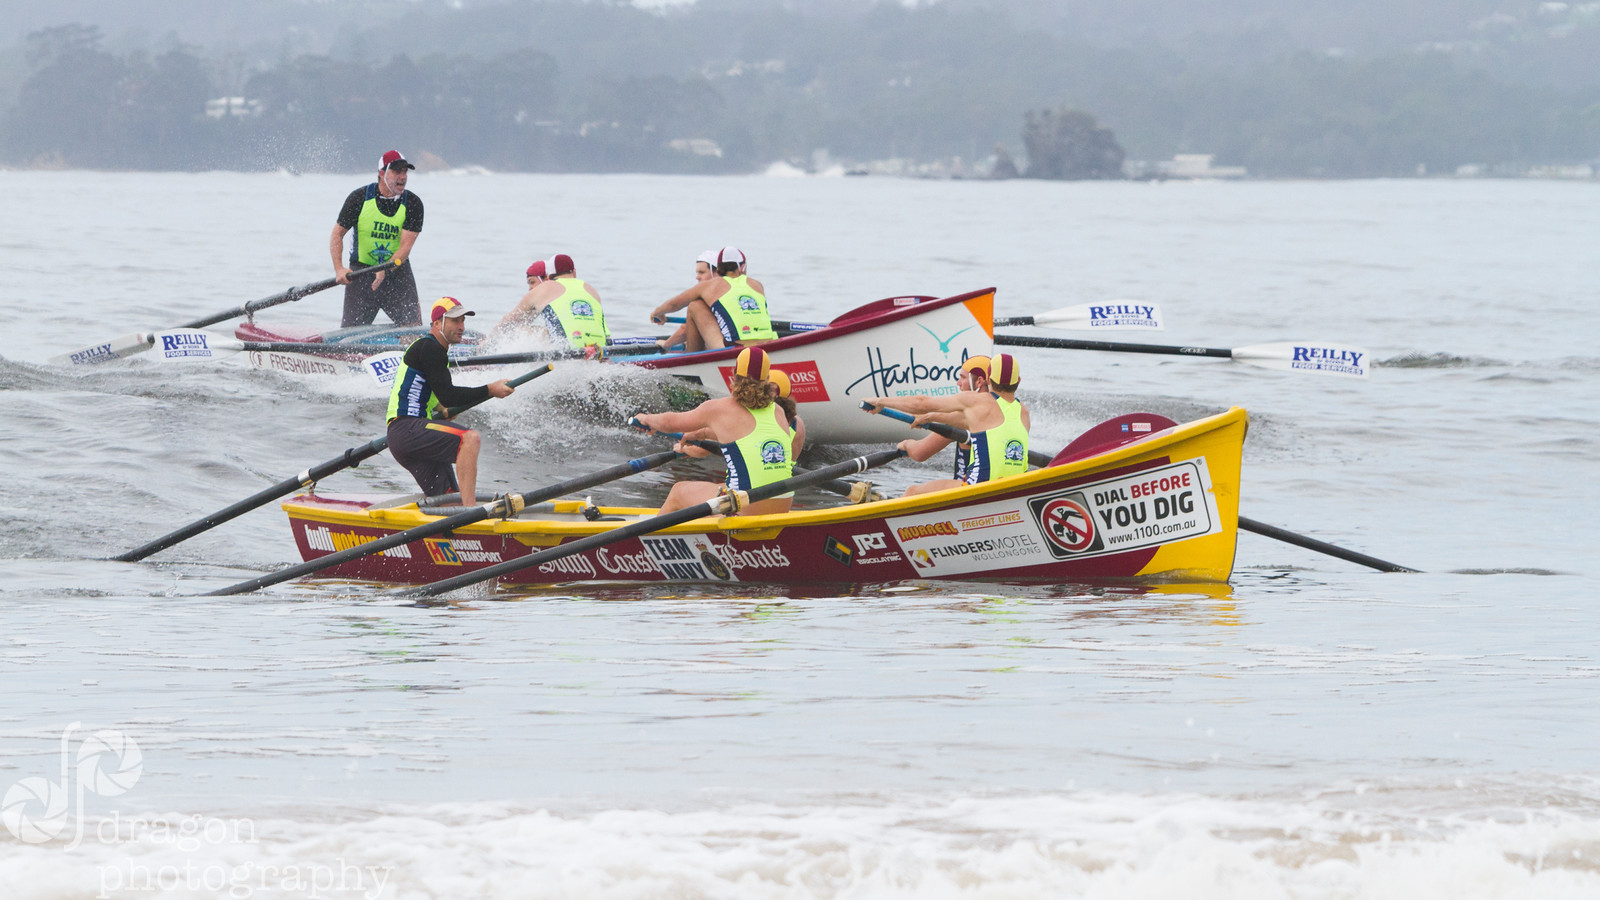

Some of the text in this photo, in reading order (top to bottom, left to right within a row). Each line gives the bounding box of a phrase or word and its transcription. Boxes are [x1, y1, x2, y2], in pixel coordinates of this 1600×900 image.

[371, 231, 398, 241] NAVY
[373, 221, 400, 234] TEAM
[1088, 305, 1154, 320] REILLY
[161, 333, 208, 351] REILLY
[70, 343, 112, 365] REILLY
[1292, 346, 1364, 367] REILLY
[269, 353, 338, 375] FRESHWATER
[790, 371, 816, 383] ORS
[896, 388, 928, 397] BEACH
[1094, 472, 1191, 507] DIAL BEFORE
[1098, 490, 1194, 530] YOU DIG
[897, 512, 1022, 543] MURRELL FREIGHT LINES
[1108, 519, 1196, 544] www.1100.com.au
[426, 541, 459, 563] HTS
[450, 539, 484, 551] HORNBY
[642, 538, 696, 560] TEAM
[852, 532, 888, 557] JRT
[971, 546, 1042, 562] WOLLONGONG
[456, 551, 503, 563] TRANSPORT
[596, 547, 662, 574] Coast
[714, 544, 791, 573] Boats
[856, 555, 902, 565] BRICKLAYING
[660, 562, 709, 580] NAVY
